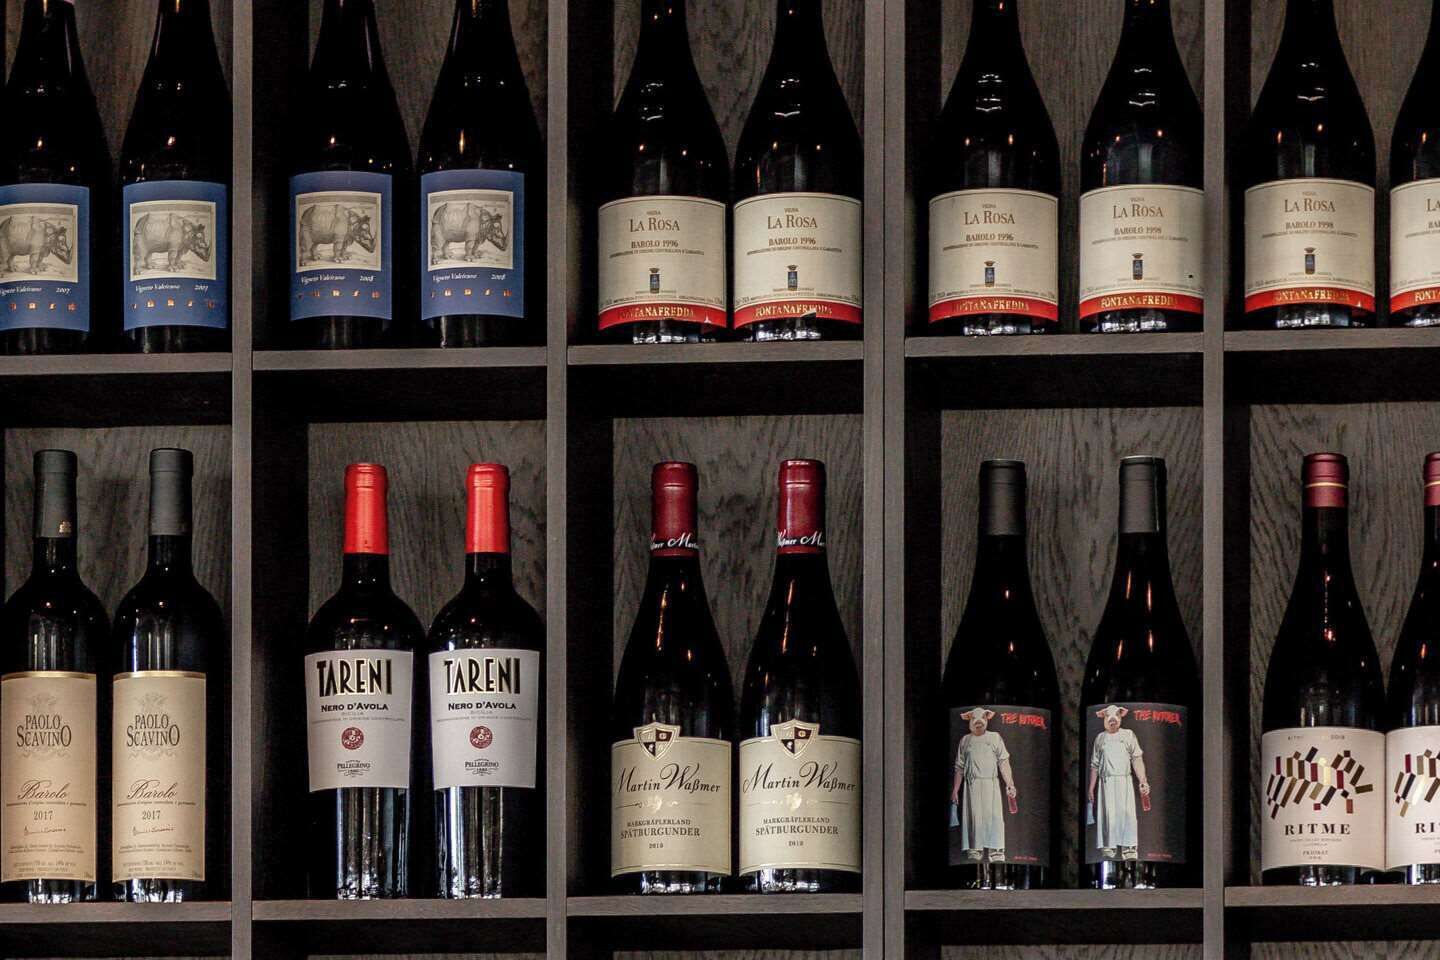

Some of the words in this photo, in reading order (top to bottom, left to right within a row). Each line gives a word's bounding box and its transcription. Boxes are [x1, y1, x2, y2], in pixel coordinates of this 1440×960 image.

[1113, 205, 1128, 218] LA
[1132, 204, 1164, 218] ROSA
[1284, 199, 1300, 213] LA
[1304, 198, 1336, 212] ROSA
[630, 219, 644, 232] LA
[648, 217, 680, 231] ROSA
[767, 216, 782, 229] LA
[786, 215, 818, 229] ROSA
[964, 212, 980, 225] LA
[983, 211, 1015, 225] ROSA
[1114, 227, 1143, 235] BAROLO
[1285, 222, 1316, 230] BAROLO
[631, 240, 660, 249] BAROLO
[663, 239, 679, 248] 1996
[768, 237, 797, 246] BAROLO
[800, 237, 816, 245] 1996
[966, 234, 995, 242] BAROLO
[316, 658, 392, 697] TARENI
[443, 657, 520, 695] TARENI
[321, 703, 344, 712] NERO
[448, 702, 473, 711] NERO
[25, 715, 61, 730] PAOLO
[134, 714, 170, 729] PAOLO
[16, 724, 72, 747] SCAVINO
[126, 723, 180, 747] SCAVINO
[616, 766, 661, 793] Martin
[660, 763, 721, 794] Waßmer
[743, 762, 800, 793] Martin
[799, 760, 856, 792] Waßmer
[17, 779, 71, 800] Barolo
[127, 779, 178, 800] Barolo
[33, 810, 53, 821] 2017
[142, 810, 161, 820] 2017
[620, 827, 700, 839] SPÄTBURGUNDER
[755, 824, 839, 836] SPÄTBURGUNDER
[1285, 823, 1350, 835] RITME
